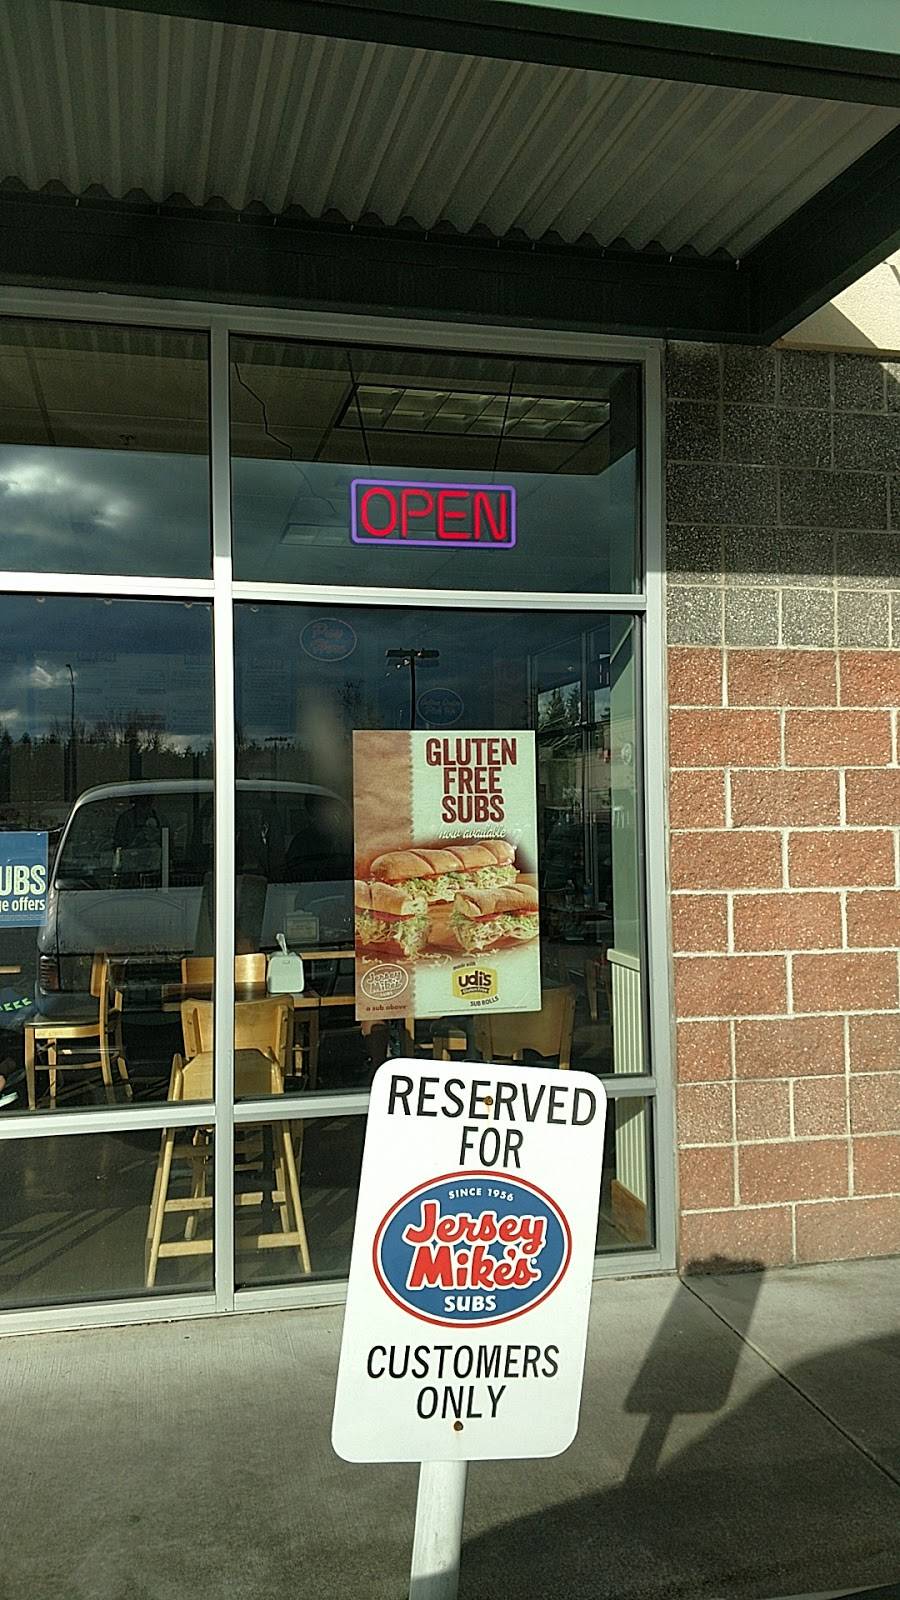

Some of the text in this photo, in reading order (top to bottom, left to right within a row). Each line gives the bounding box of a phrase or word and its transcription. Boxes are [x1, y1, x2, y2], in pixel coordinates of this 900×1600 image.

[360, 486, 508, 542] OPEN
[425, 738, 517, 766] GLUTEN
[443, 767, 503, 795] FREE
[441, 795, 505, 824] SUBS
[439, 825, 506, 839] now available
[12, 897, 46, 911] offers
[458, 970, 492, 987] udi's
[482, 996, 499, 1005] ROLLS
[387, 1074, 597, 1126] RESERVED
[458, 1125, 524, 1168] FOR
[448, 1187, 515, 1202] SINCE 1956
[404, 1201, 546, 1252] Jersey
[407, 1245, 537, 1290] Mike's
[444, 1294, 497, 1313] SUBS
[366, 1344, 560, 1379] CUSTOMERS
[416, 1384, 506, 1420] ONLY
